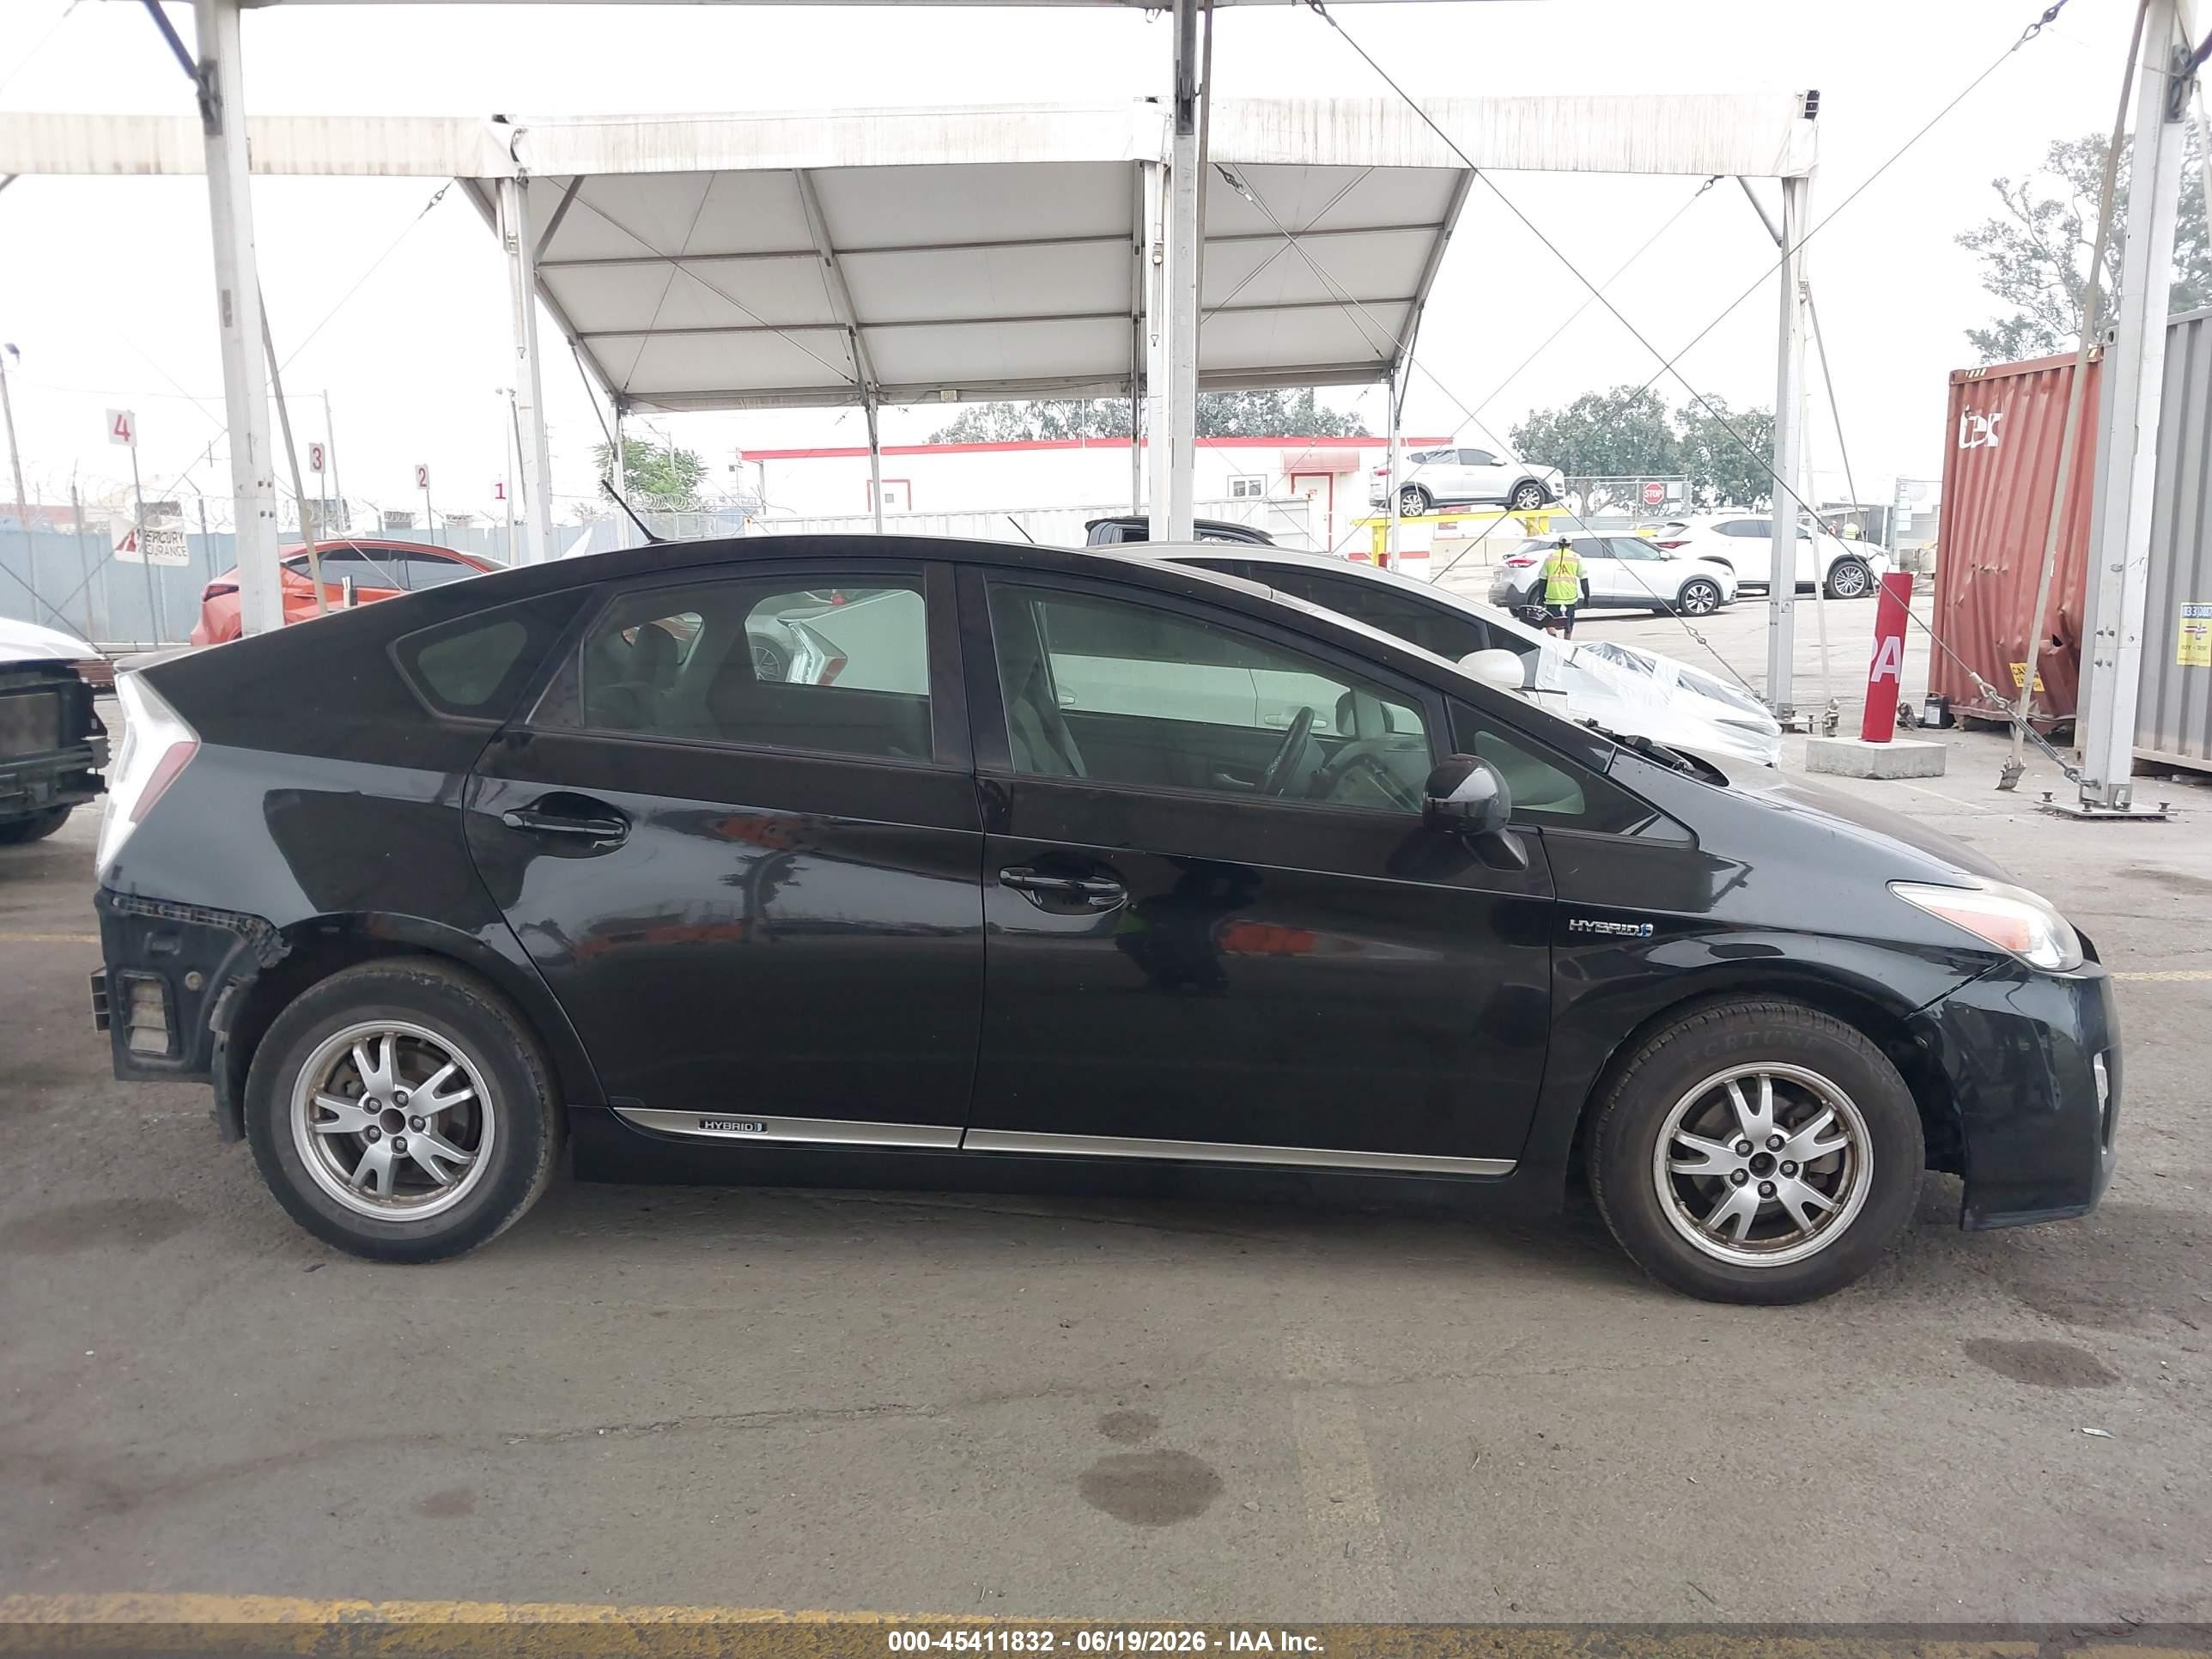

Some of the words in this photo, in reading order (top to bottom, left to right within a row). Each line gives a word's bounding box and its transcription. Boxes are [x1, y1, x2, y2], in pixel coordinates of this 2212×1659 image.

[113, 414, 131, 441] 4
[312, 447, 322, 470] 3
[418, 467, 427, 487] 2
[495, 483, 506, 499] 1
[137, 543, 188, 556] SURANCE
[1569, 919, 1640, 937] HYBRID
[705, 1121, 753, 1131] HYBRID
